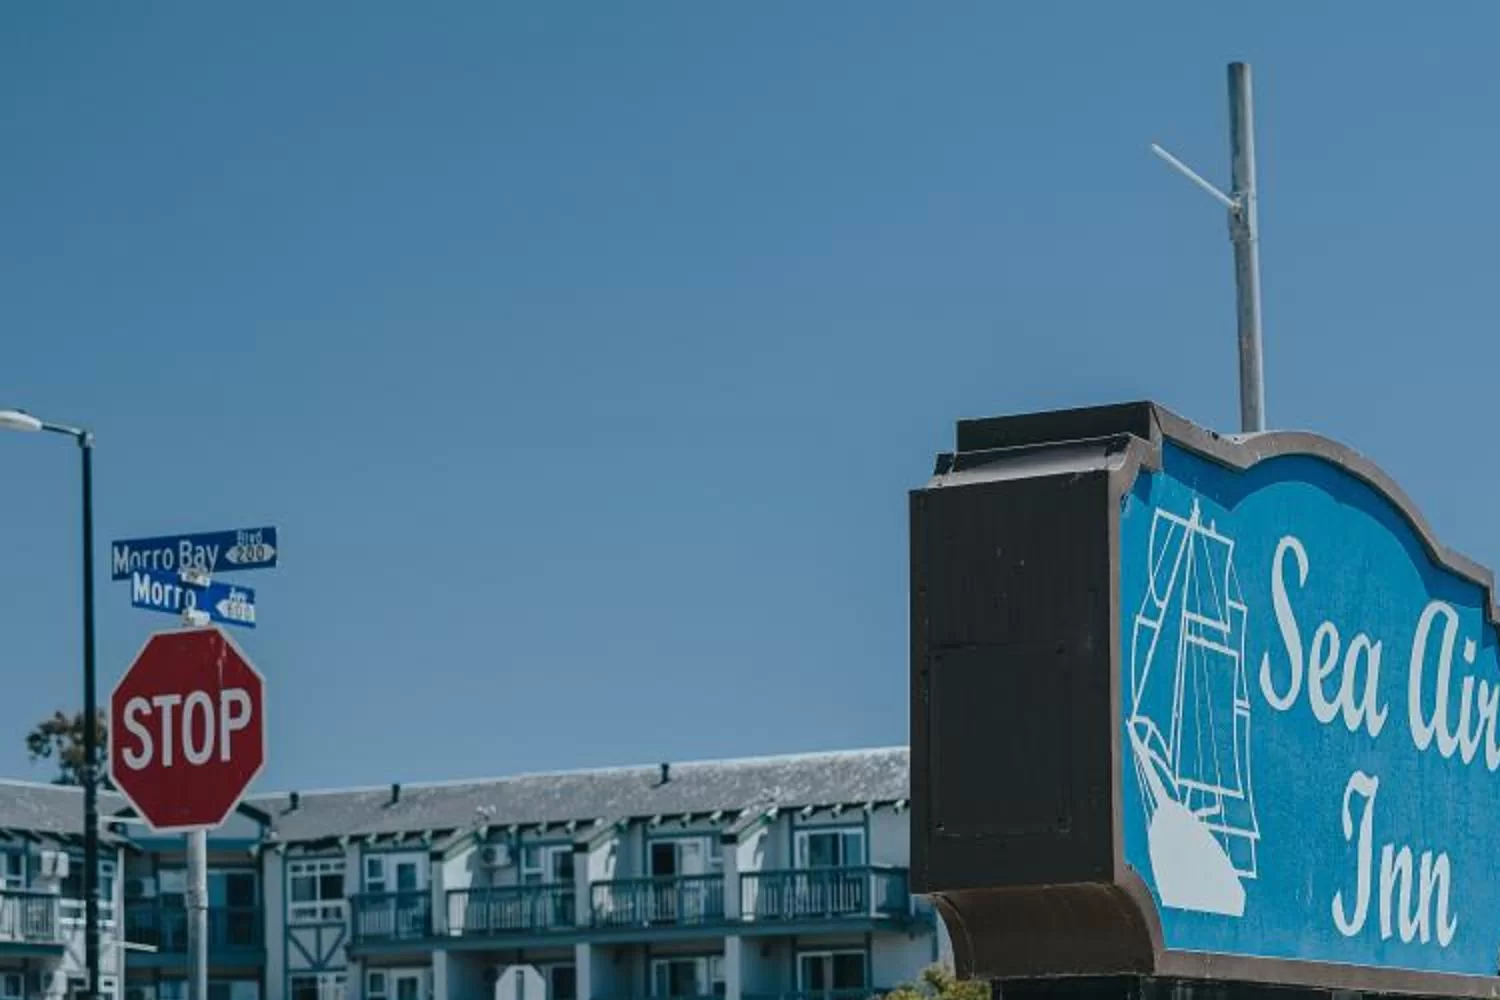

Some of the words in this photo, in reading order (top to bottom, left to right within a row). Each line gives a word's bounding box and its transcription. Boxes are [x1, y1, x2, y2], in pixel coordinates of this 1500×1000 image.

[113, 544, 175, 575] Morro
[179, 539, 220, 574] Bay
[133, 571, 197, 610] Morro
[1260, 535, 1389, 737] Sea
[121, 687, 252, 770] STOP
[1332, 770, 1458, 947] Inn
